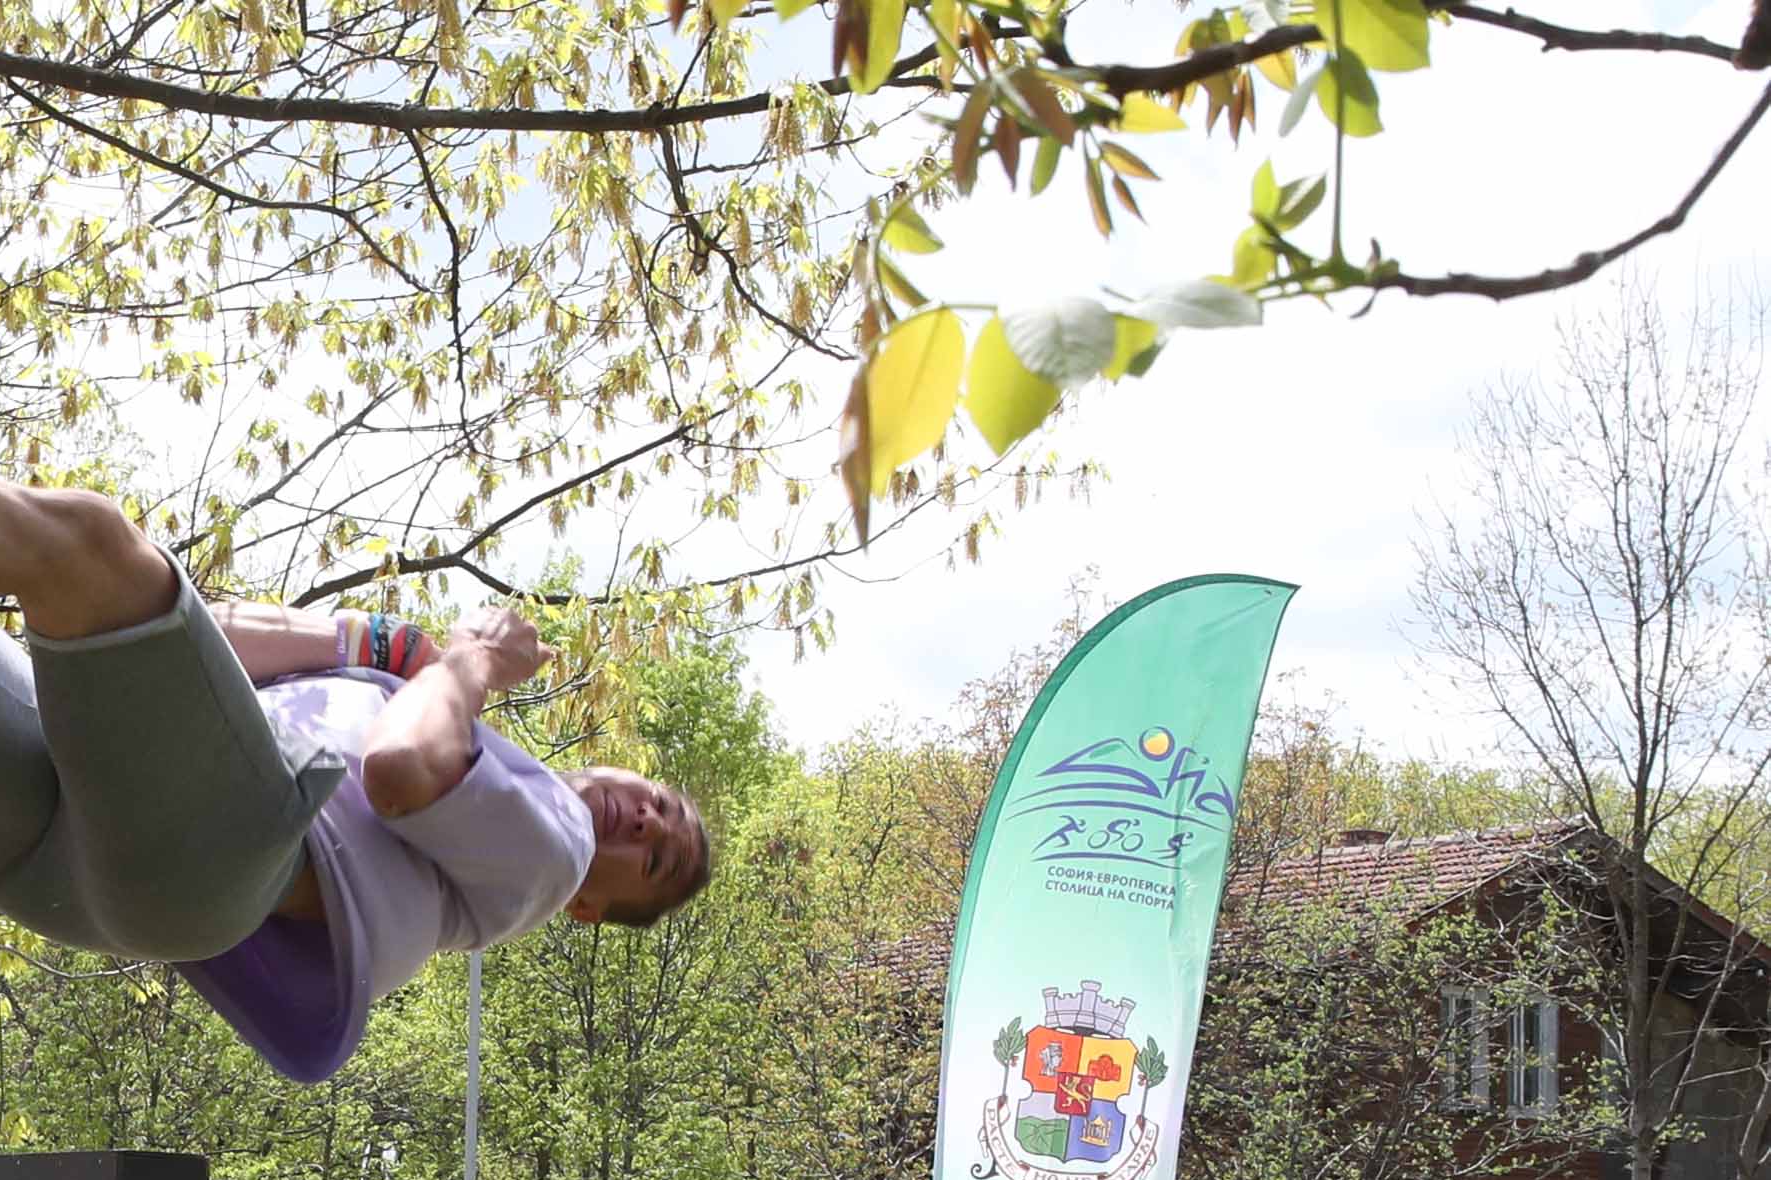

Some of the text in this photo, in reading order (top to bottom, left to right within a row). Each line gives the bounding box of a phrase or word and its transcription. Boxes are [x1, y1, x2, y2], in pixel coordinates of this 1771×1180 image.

[1045, 879, 1175, 911] СТОЛИЦА НА СПОРТА
